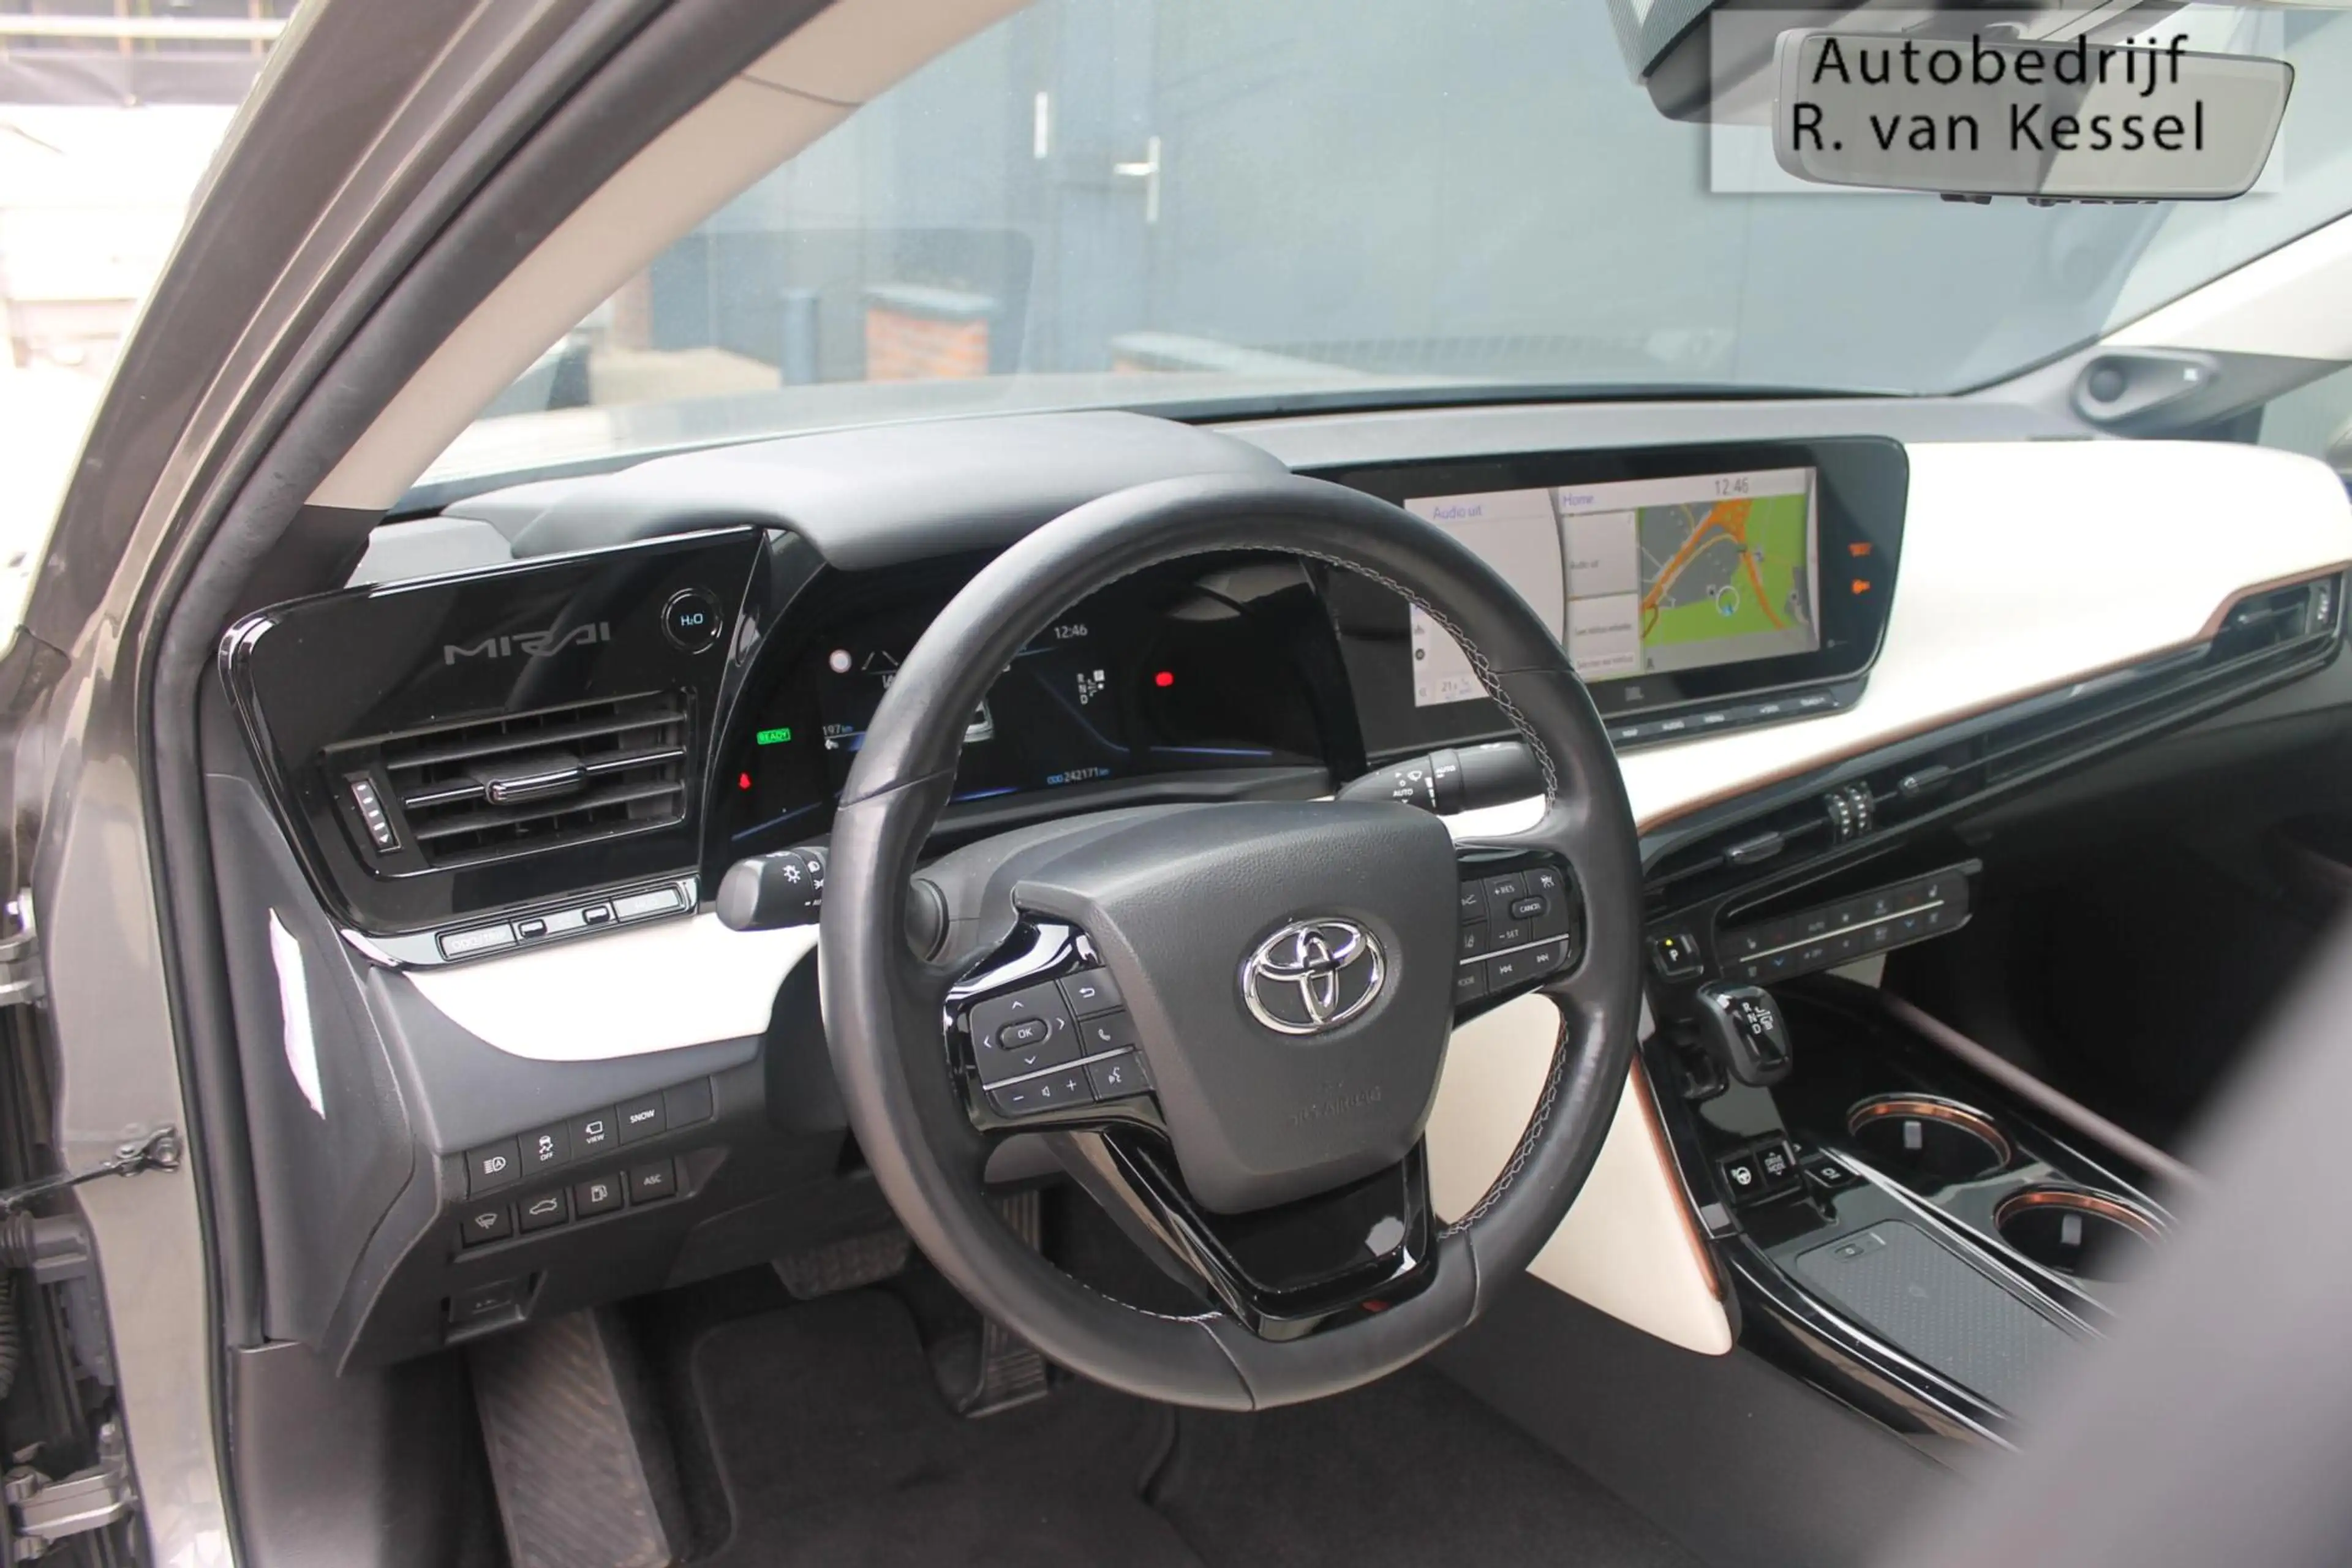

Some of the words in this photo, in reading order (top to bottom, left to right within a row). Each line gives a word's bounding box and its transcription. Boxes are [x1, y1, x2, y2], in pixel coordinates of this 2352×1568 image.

[1562, 492, 1594, 507] Home
[1433, 505, 1466, 520] Audio
[1467, 504, 1483, 518] uit
[1054, 624, 1088, 639] 12:46
[443, 620, 611, 666] MIRAI
[1393, 788, 1414, 797] AUTO
[1017, 1027, 1033, 1039] OK
[630, 1109, 655, 1123] SNOW
[586, 1133, 605, 1144] VIEW
[540, 1151, 553, 1161] OFF
[644, 1174, 662, 1186] ASC
